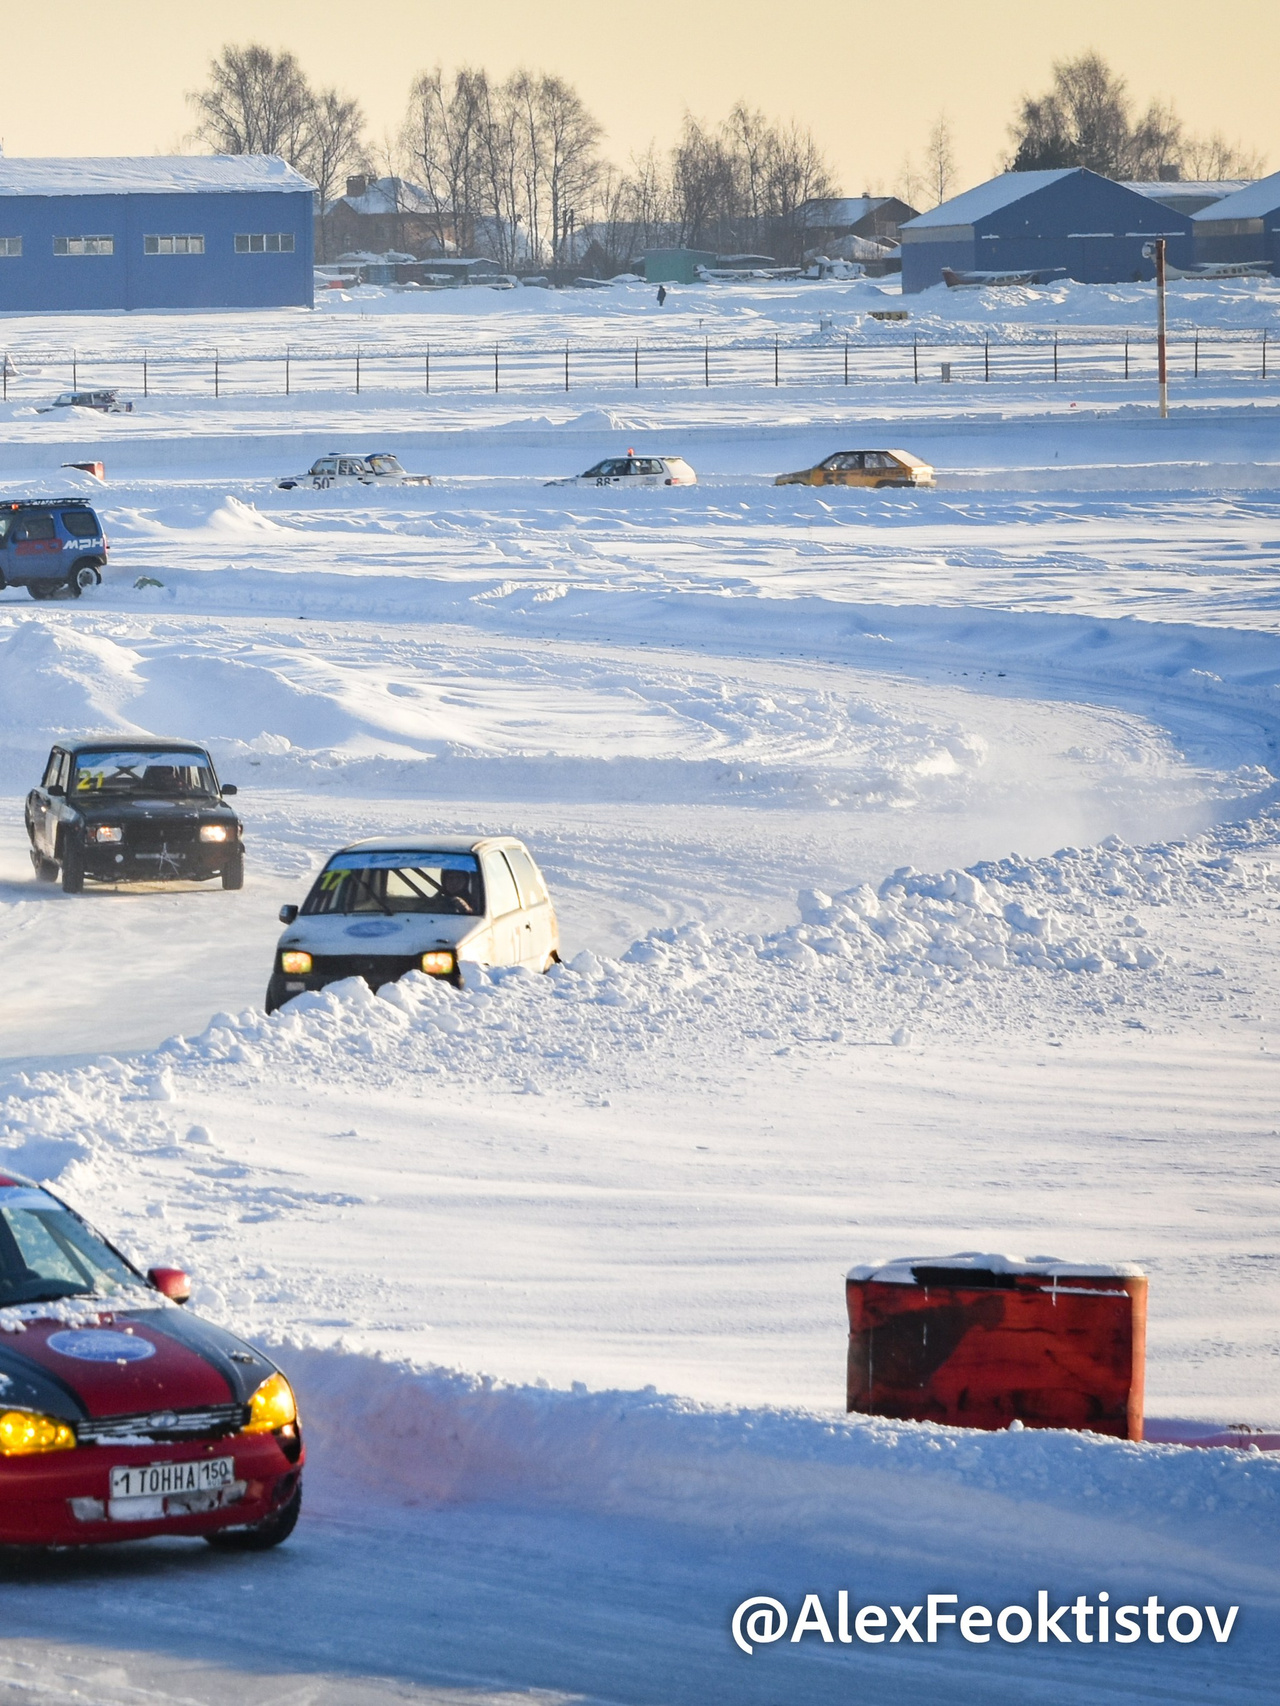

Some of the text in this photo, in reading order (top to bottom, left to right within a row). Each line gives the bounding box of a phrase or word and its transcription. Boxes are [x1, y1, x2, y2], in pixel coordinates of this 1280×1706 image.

[312, 477, 330, 490] 50
[62, 538, 104, 550] MPH
[76, 770, 105, 791] 21
[320, 869, 352, 891] 17
[120, 1472, 131, 1494] 1
[201, 1460, 228, 1480] 150
